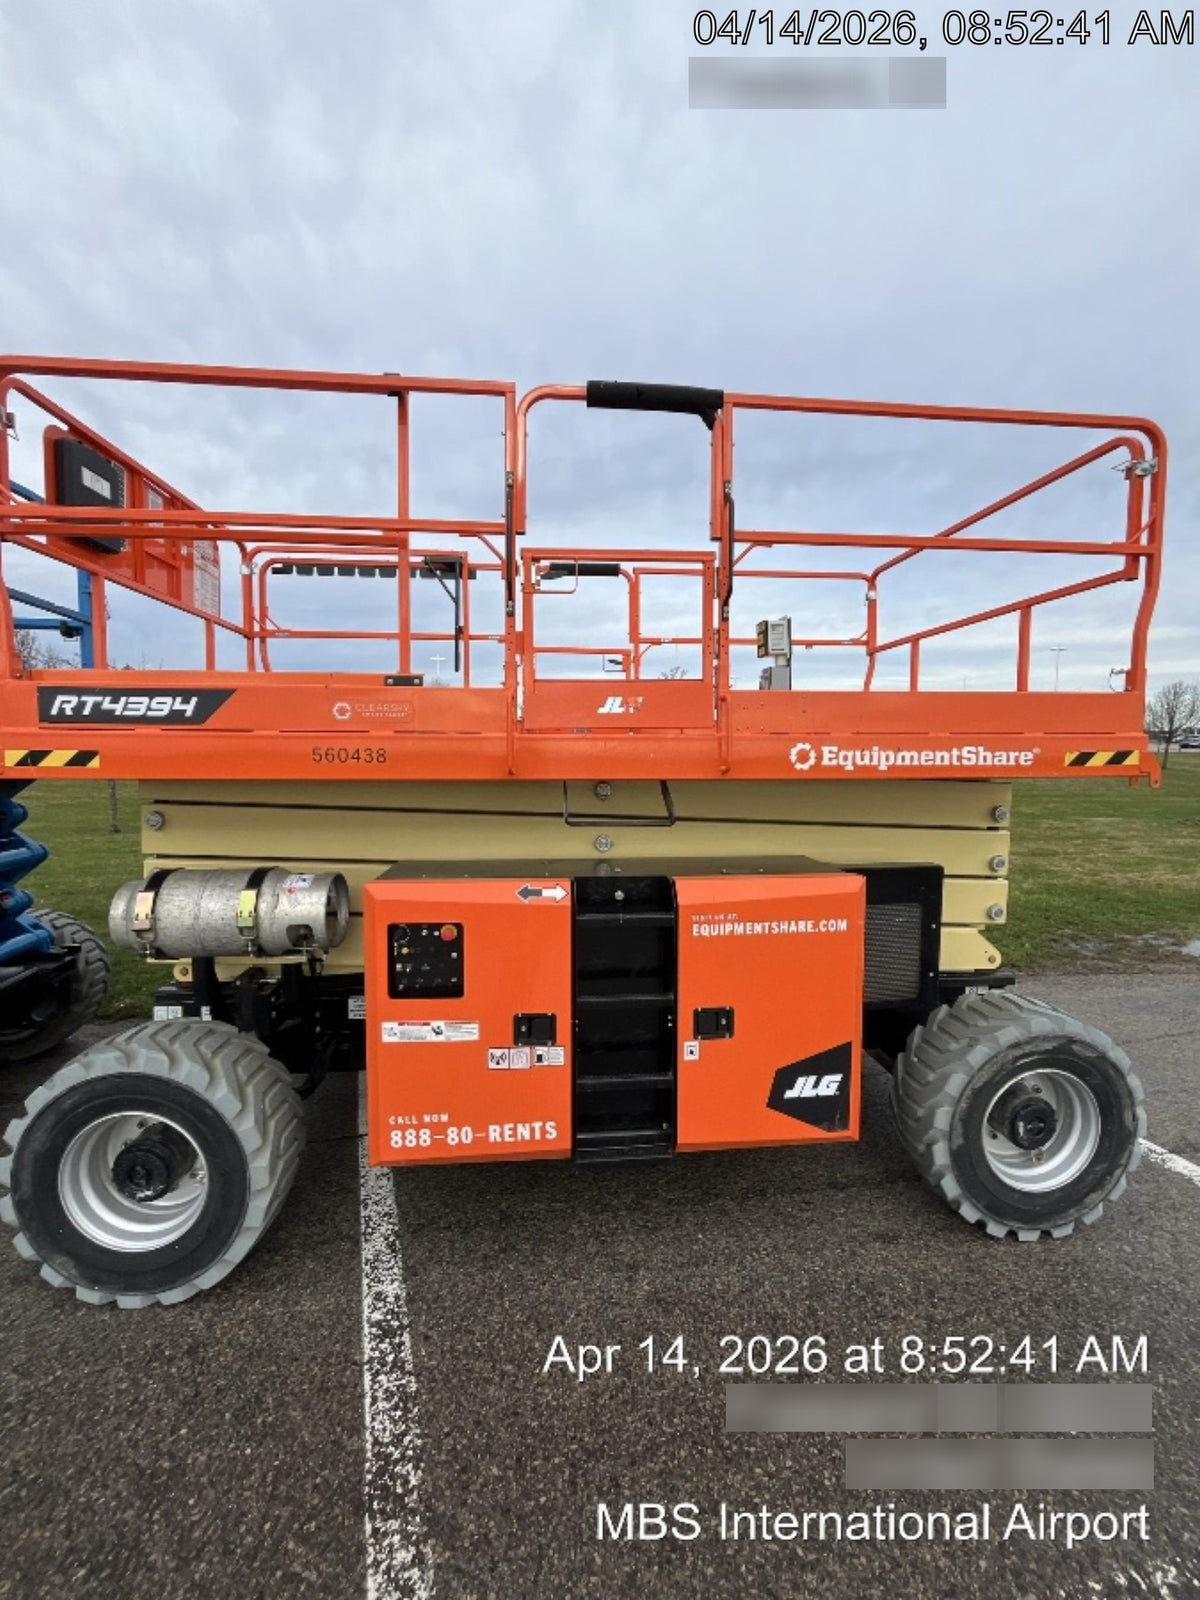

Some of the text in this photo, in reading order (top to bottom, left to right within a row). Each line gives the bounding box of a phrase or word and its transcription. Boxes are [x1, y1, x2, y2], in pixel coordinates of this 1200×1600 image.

[49, 694, 198, 717] RT4394
[312, 747, 387, 763] 560438
[821, 746, 1035, 771] EquipmentShare
[692, 919, 848, 937] EQUIPMENTSHARE.COM
[784, 1073, 843, 1099] JLG
[389, 1112, 449, 1125] CALL NOW
[390, 1121, 557, 1148] 888-80-RENTS
